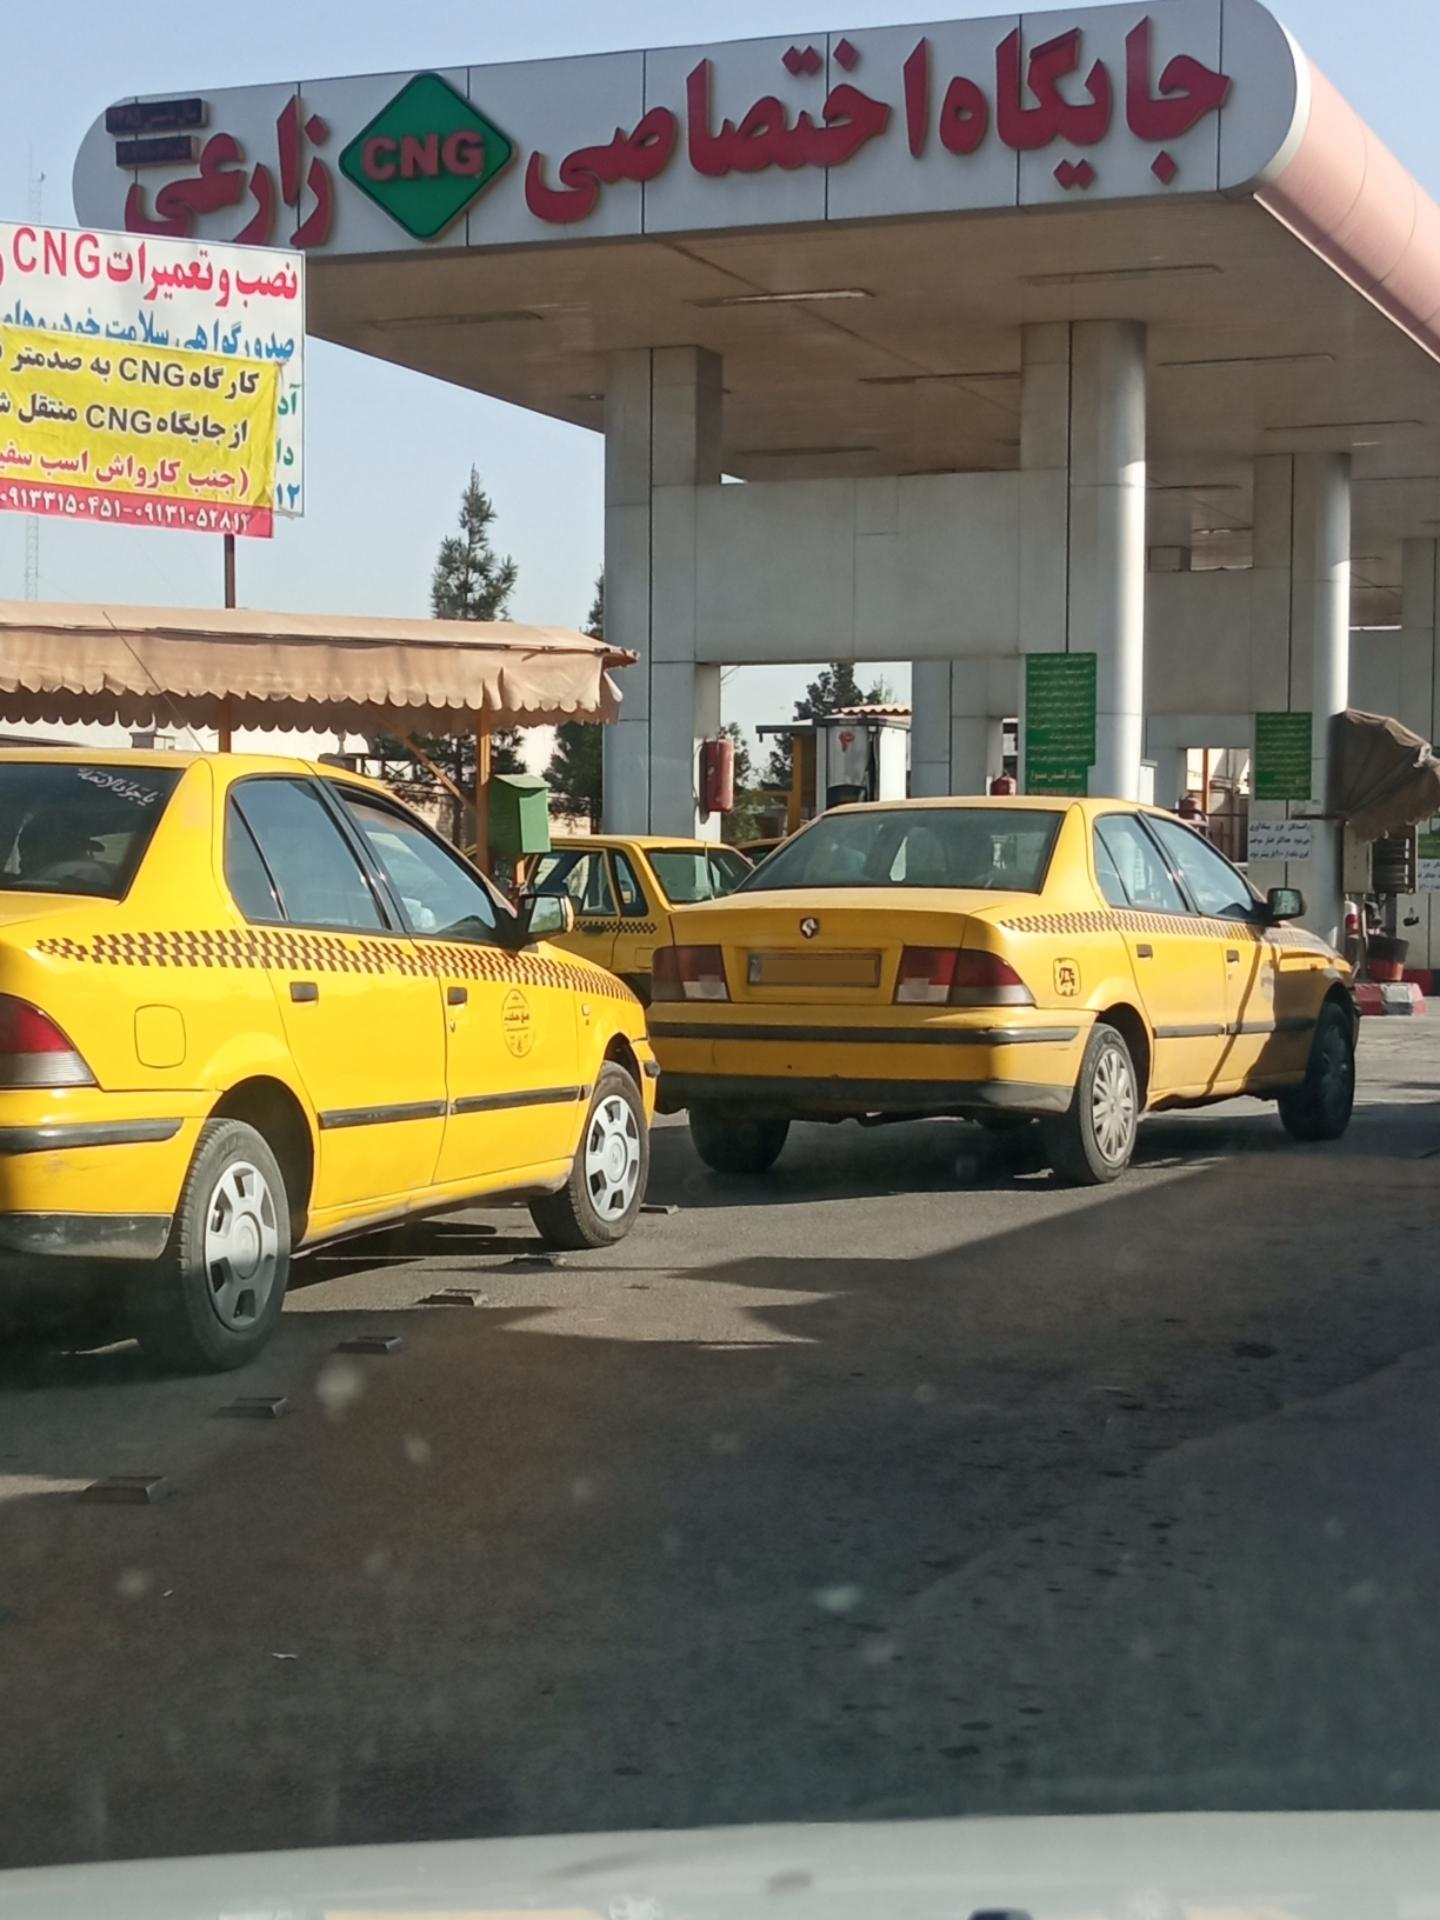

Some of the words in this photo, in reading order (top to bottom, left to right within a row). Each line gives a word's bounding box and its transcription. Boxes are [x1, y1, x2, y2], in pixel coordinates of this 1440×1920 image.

[939, 15, 1231, 189] جایگاه
[525, 36, 927, 223] اختصاصی
[124, 94, 331, 248] زارعی
[361, 129, 485, 181] CNG
[13, 227, 100, 279] CNG
[106, 241, 214, 301] تعمیرات
[215, 268, 230, 307] و
[236, 261, 298, 308] نصب
[105, 309, 169, 346] سلامت
[90, 356, 111, 382] به
[119, 357, 185, 387] CNG
[190, 365, 260, 399] کارگاه
[18, 393, 78, 423] منتقل
[86, 404, 152, 434] CNG
[157, 411, 226, 444] جایگاه
[228, 419, 248, 449] از
[40, 450, 89, 476] اسب
